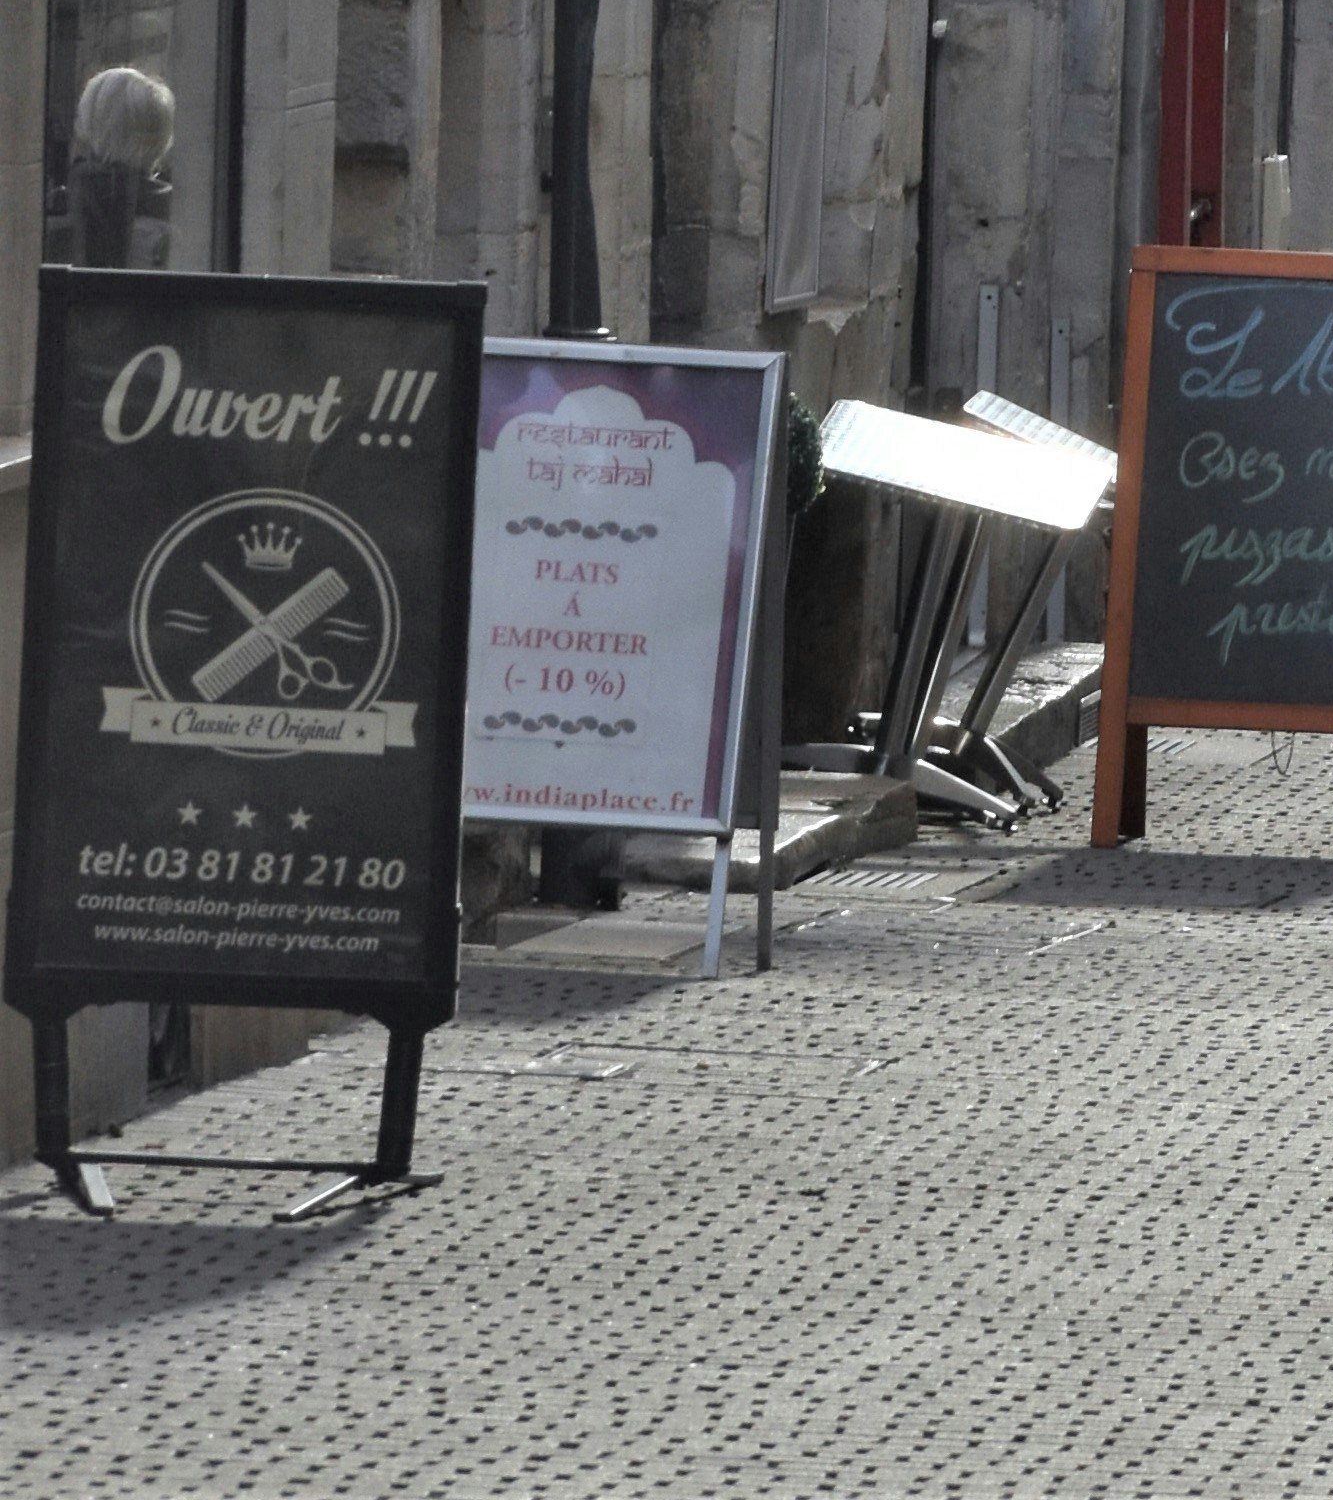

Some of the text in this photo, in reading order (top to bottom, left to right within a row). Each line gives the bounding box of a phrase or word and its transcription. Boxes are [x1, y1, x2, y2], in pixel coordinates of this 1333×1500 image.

[102, 344, 438, 448] Ouvert !!!
[515, 420, 675, 453] restaurant
[526, 456, 655, 491] taj mahal
[535, 559, 620, 584] PLATS
[490, 625, 648, 656] EMPORTER
[172, 706, 346, 745] Classic & Original
[78, 842, 407, 890] tel: 03 81 81 21 80
[76, 892, 401, 924] contact@salon-pierre-yves.com
[94, 924, 380, 953] www.salon-pierre-yves.com
